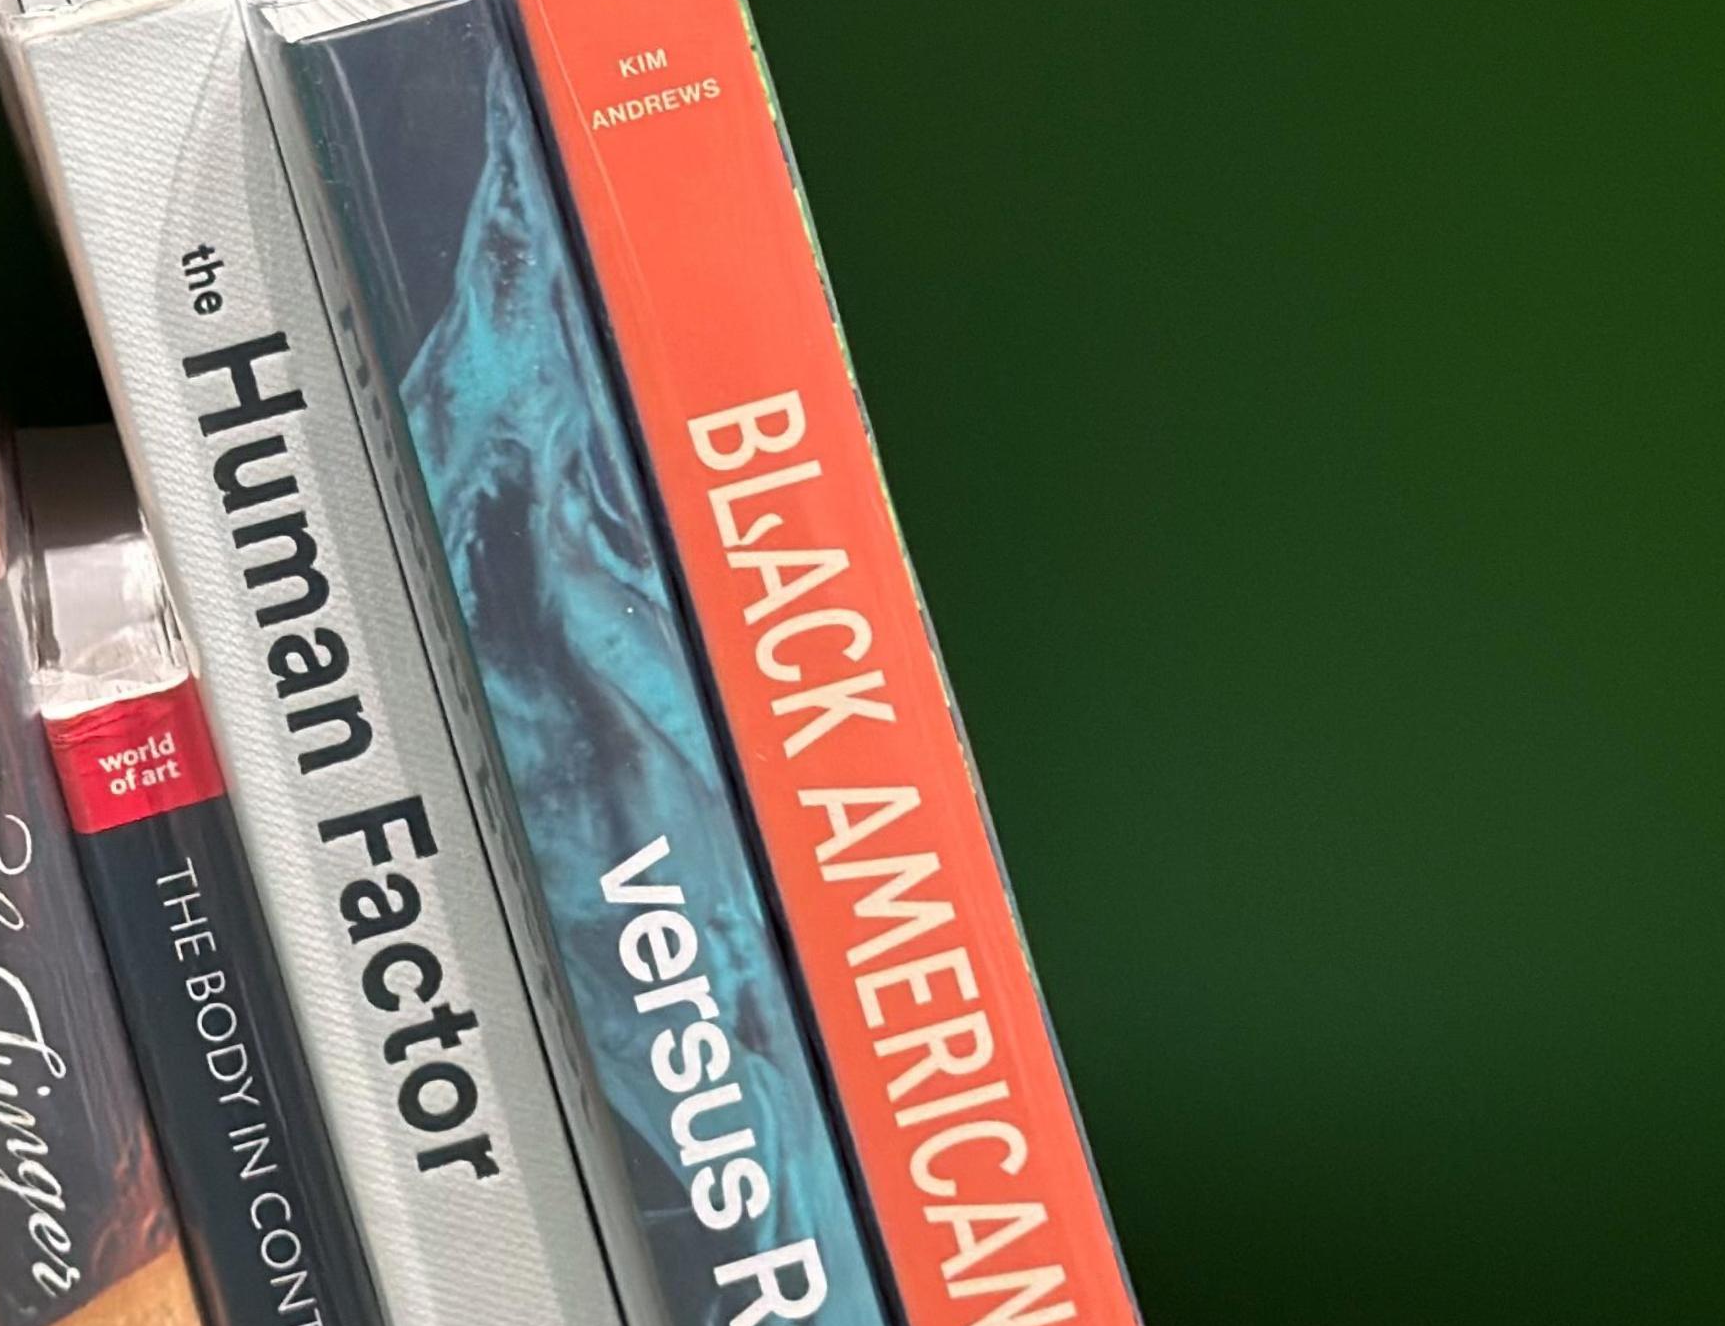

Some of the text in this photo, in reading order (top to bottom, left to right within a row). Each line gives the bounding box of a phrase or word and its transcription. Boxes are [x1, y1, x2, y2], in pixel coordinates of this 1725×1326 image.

[591, 77, 722, 131] ANDREWS
[618, 48, 669, 79] KIM
[686, 389, 899, 760] BLACK
[98, 731, 177, 774] world
[179, 242, 501, 1182] the Human Factor
[109, 759, 182, 796] of art
[156, 857, 217, 963] THE
[185, 969, 262, 1111] BODY
[599, 833, 772, 1231] versus
[227, 1123, 278, 1184] IN
